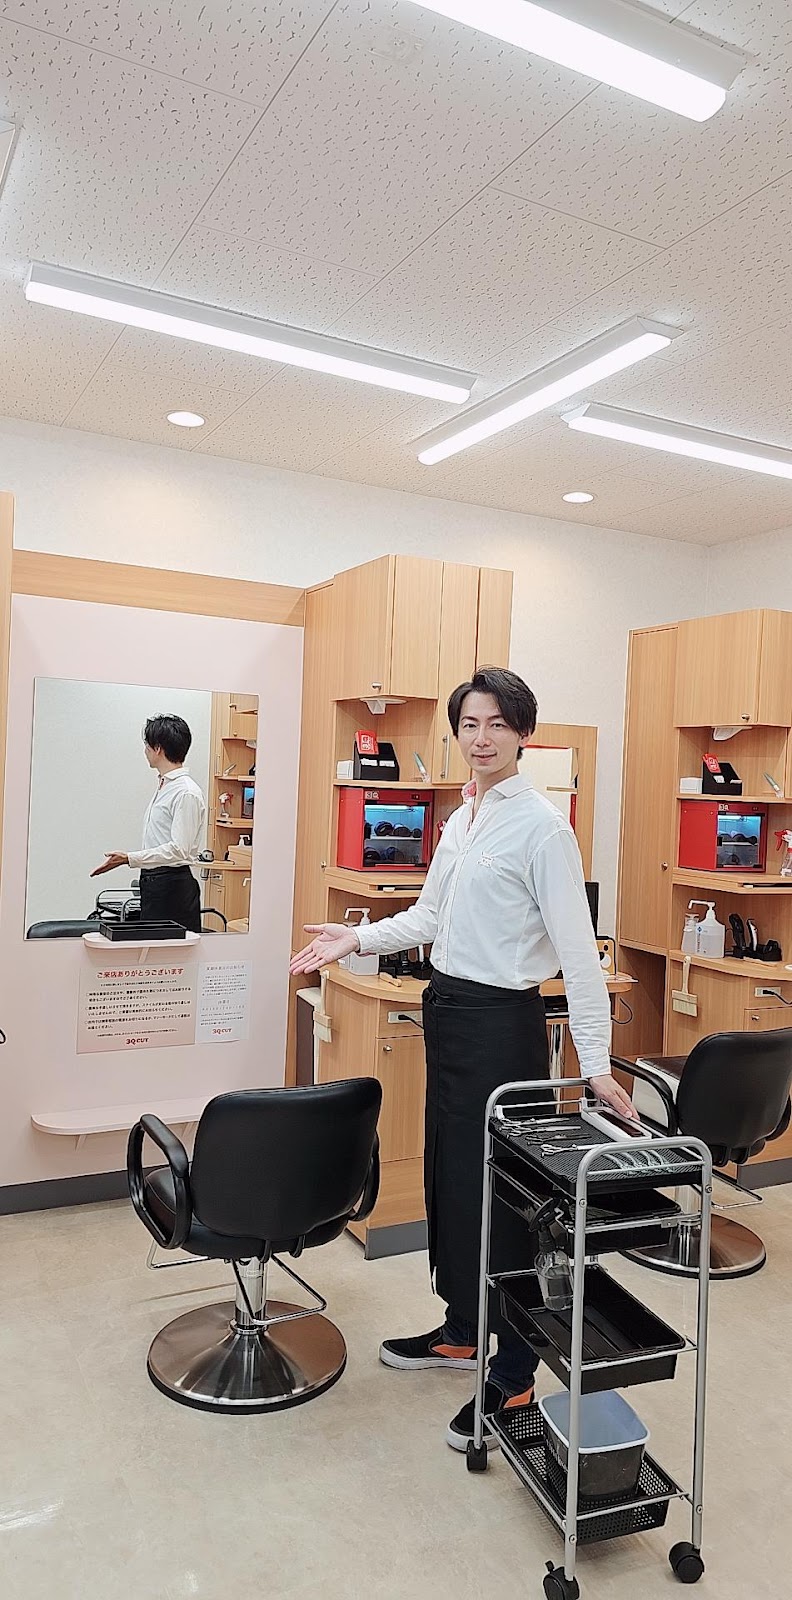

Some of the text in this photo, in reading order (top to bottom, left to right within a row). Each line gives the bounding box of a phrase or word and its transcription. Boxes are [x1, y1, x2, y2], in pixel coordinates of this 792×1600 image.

[97, 968, 184, 979] ご来店ありがとうございます
